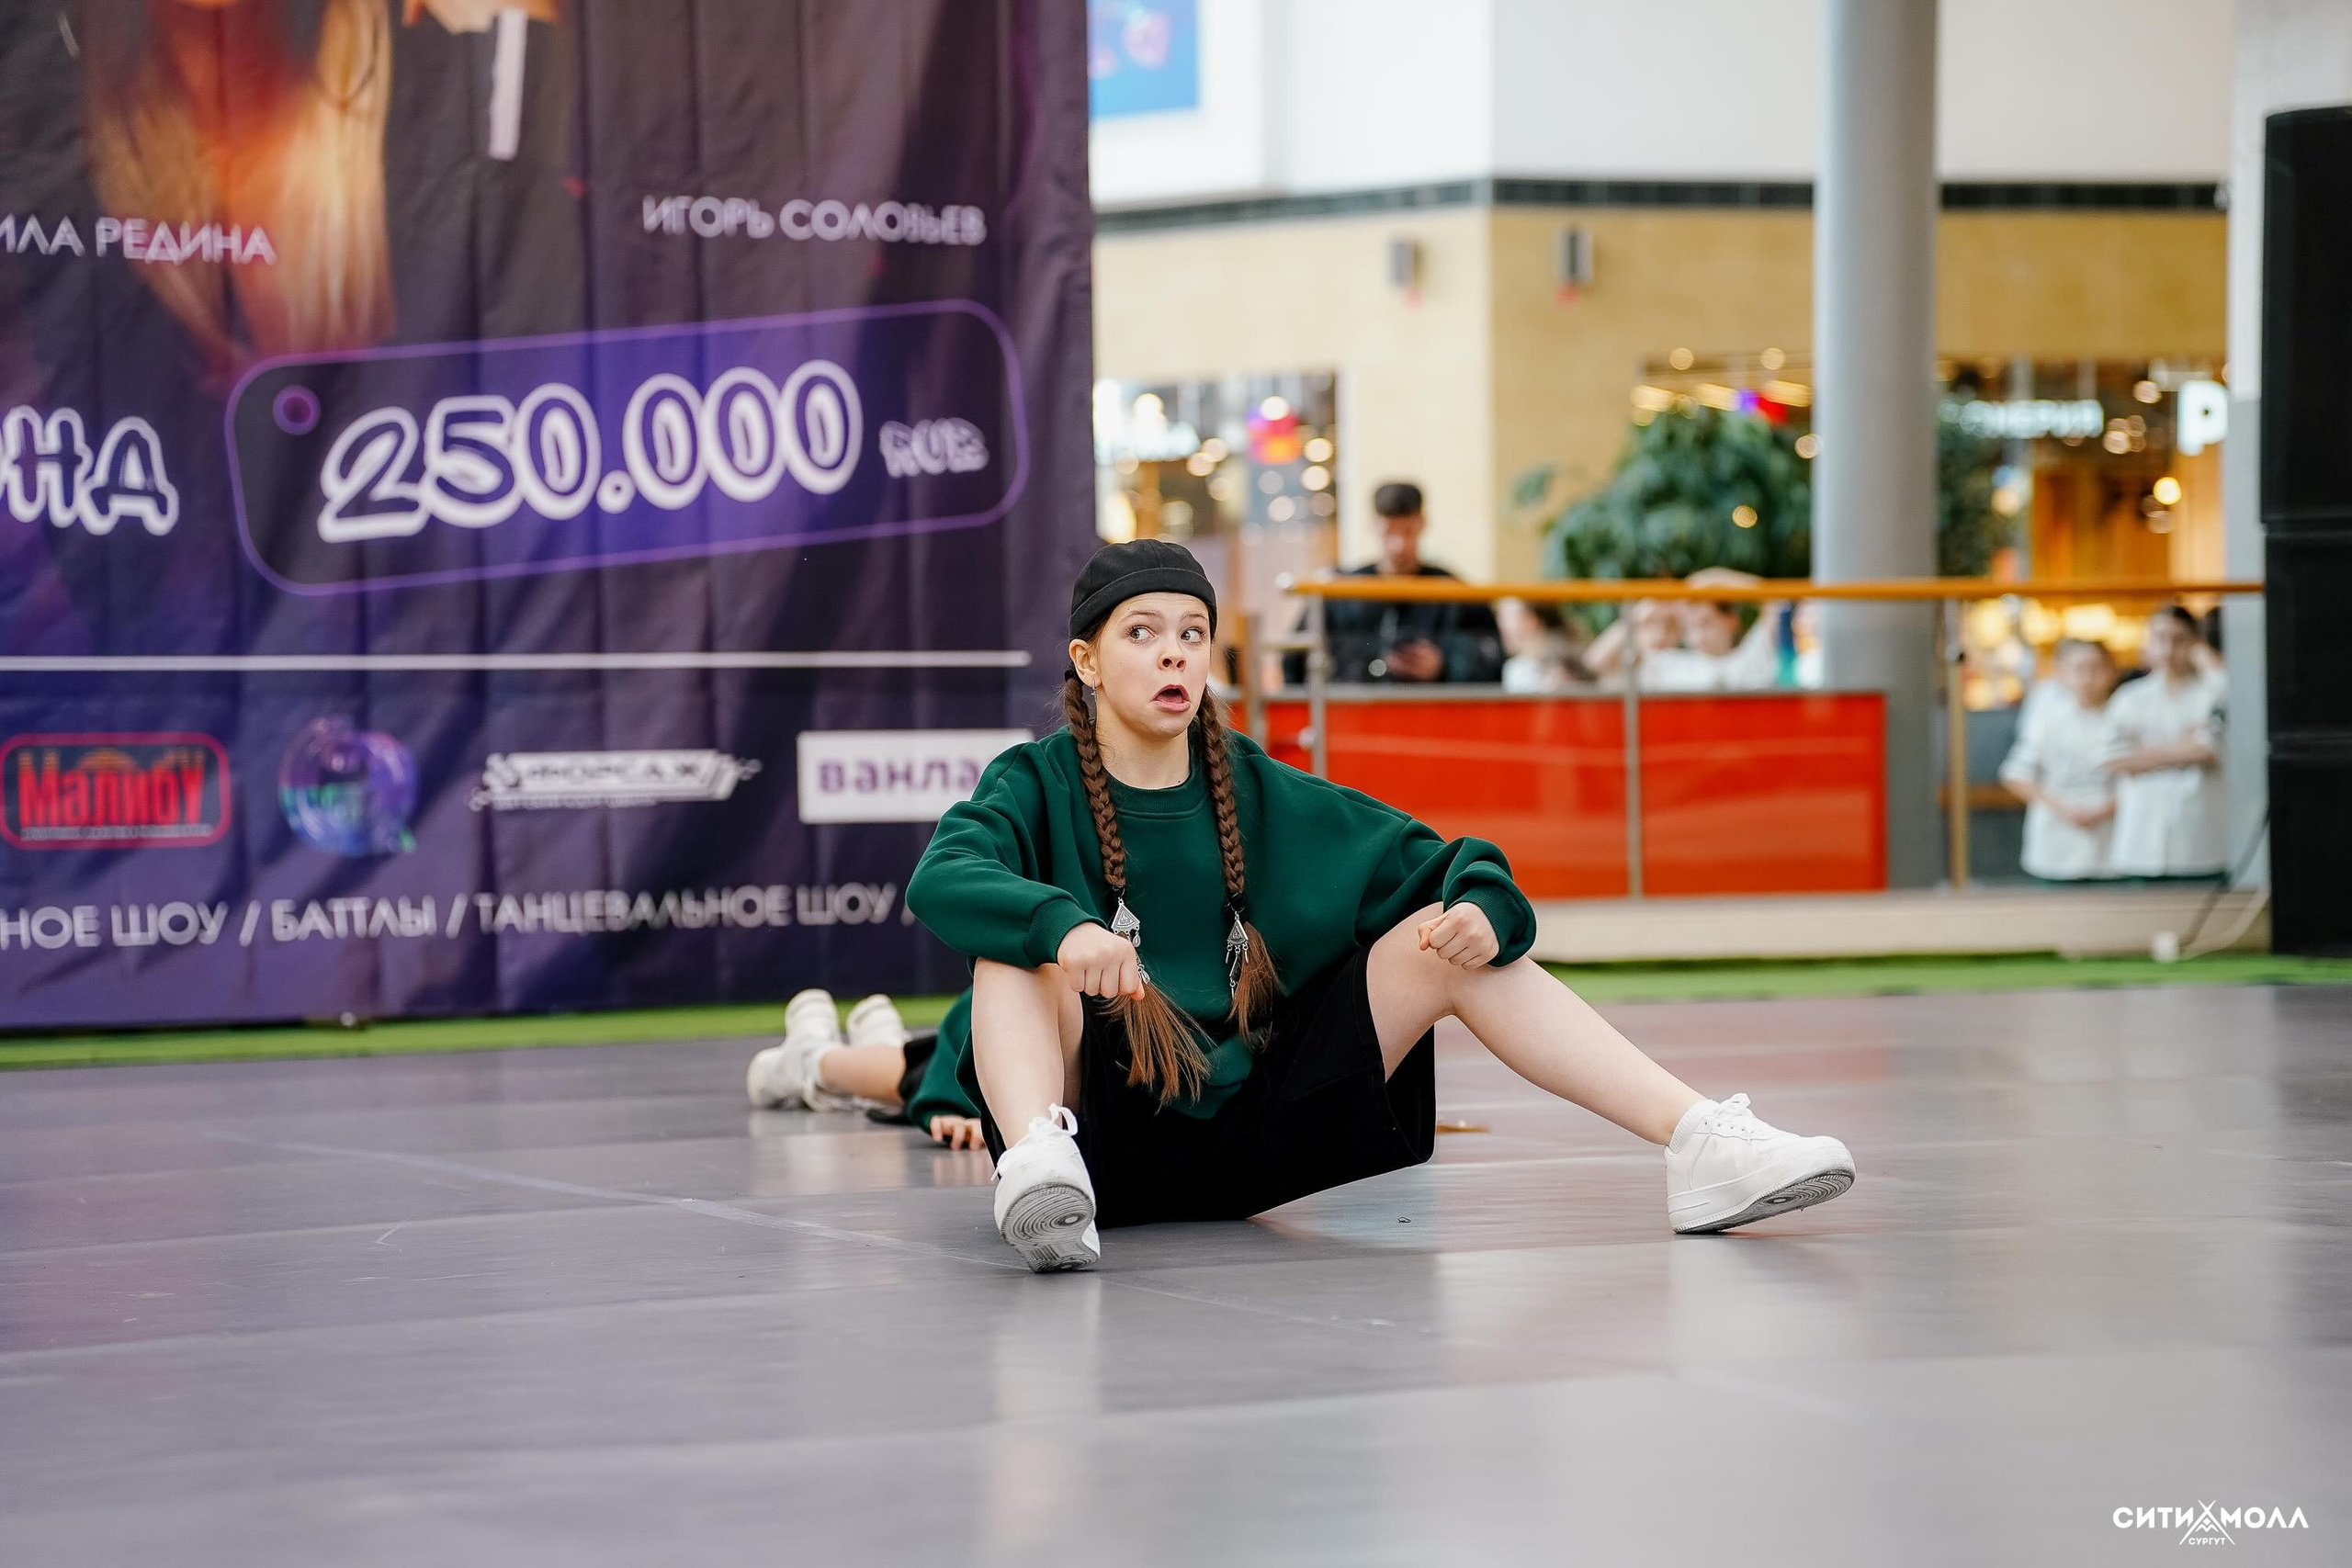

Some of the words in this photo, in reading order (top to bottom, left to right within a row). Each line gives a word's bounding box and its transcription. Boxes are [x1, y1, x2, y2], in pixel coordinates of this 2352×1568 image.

[95, 216, 277, 265] РЕДИНА
[642, 195, 775, 239] ИГОРЬ
[779, 199, 987, 245] СОЛОВЬЕВ
[0, 405, 179, 536] НД
[317, 359, 864, 543] 250.000
[820, 759, 981, 794] ванла
[0, 906, 101, 951] НОЕ
[110, 900, 229, 947] ШОУ
[272, 895, 435, 942] БАТТЛЫ
[472, 885, 789, 935] ТАНЦЕВАЛЬНОЕ
[796, 882, 898, 925] ШОУ
